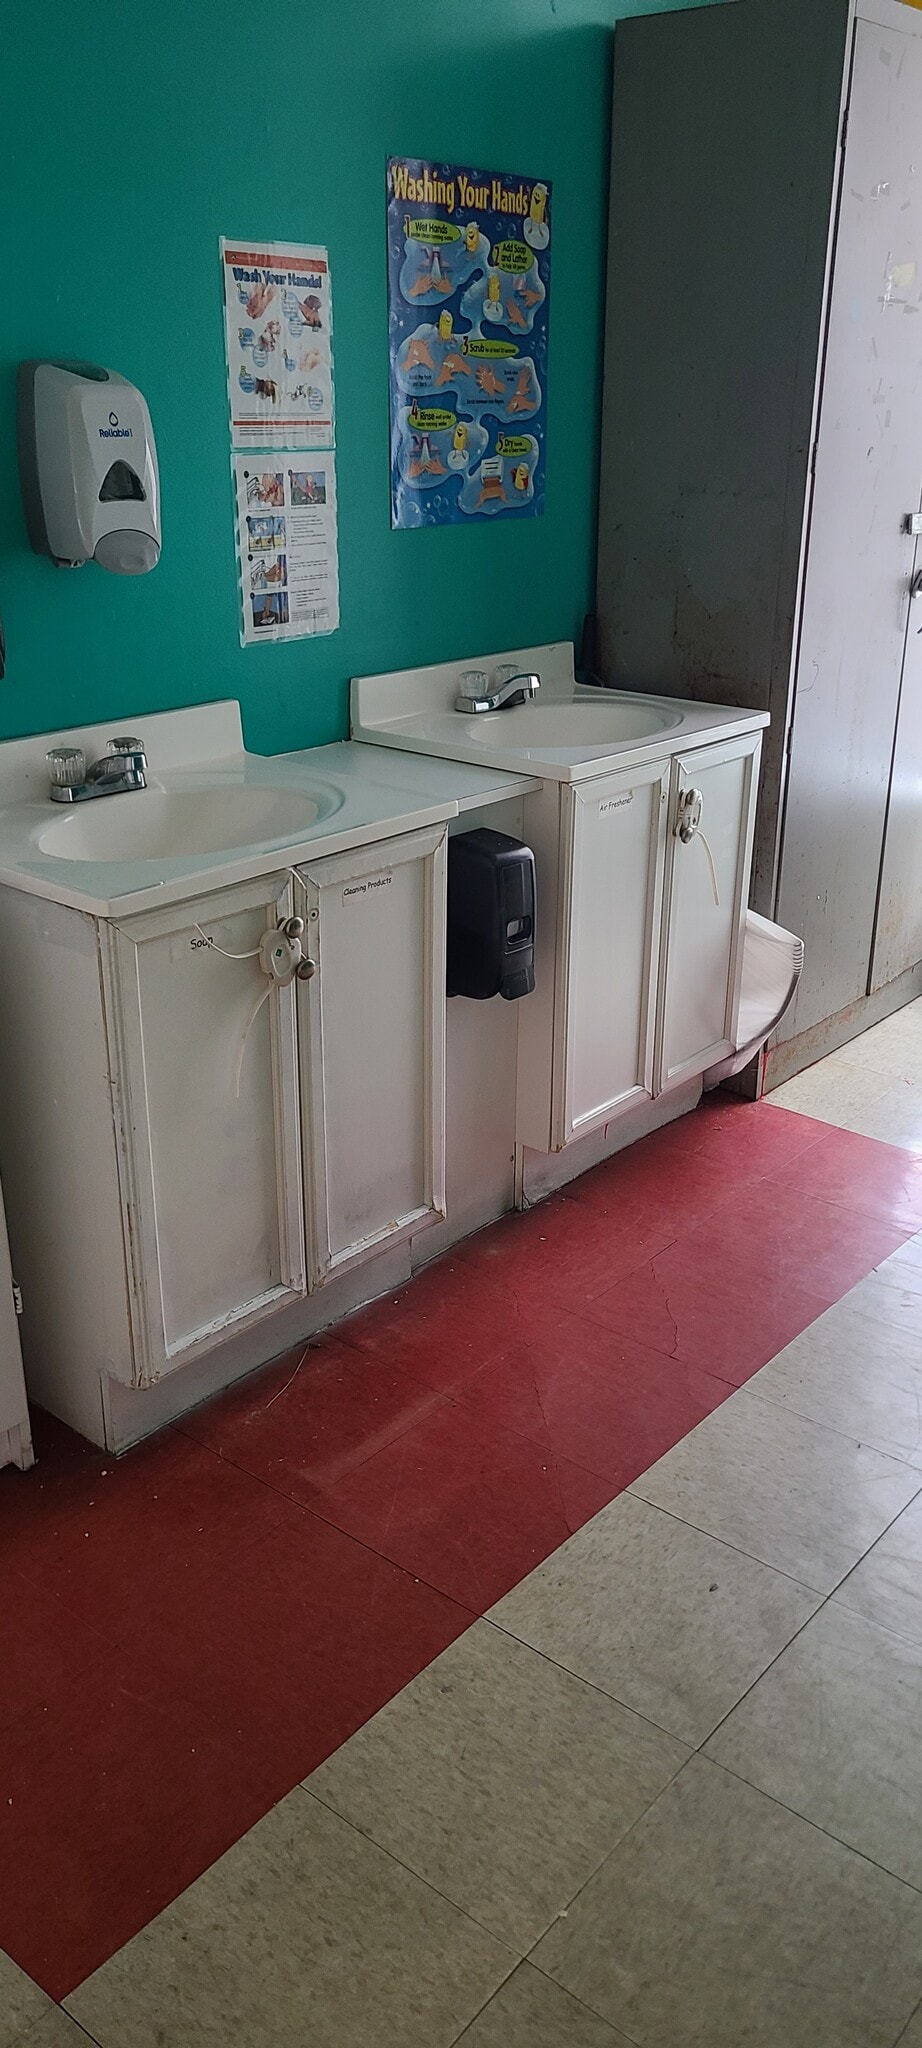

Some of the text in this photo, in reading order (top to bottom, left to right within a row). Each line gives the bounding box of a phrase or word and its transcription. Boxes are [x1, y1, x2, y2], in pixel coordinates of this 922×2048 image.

[391, 164, 529, 216] Washing Your Hands
[415, 222, 448, 234] Wet Hands
[494, 246, 500, 266] 2
[503, 242, 526, 256] Add Soap
[501, 253, 528, 263] and Lather
[232, 267, 322, 288] Wash Your Hands!
[463, 336, 469, 356] 3
[470, 342, 485, 352] Scrub
[411, 399, 418, 420] 4
[420, 411, 435, 420] Rinse
[498, 432, 504, 452] 5
[504, 438, 513, 450] Dry
[600, 796, 634, 812] Air Freshener
[343, 877, 392, 896] Cleaning Products
